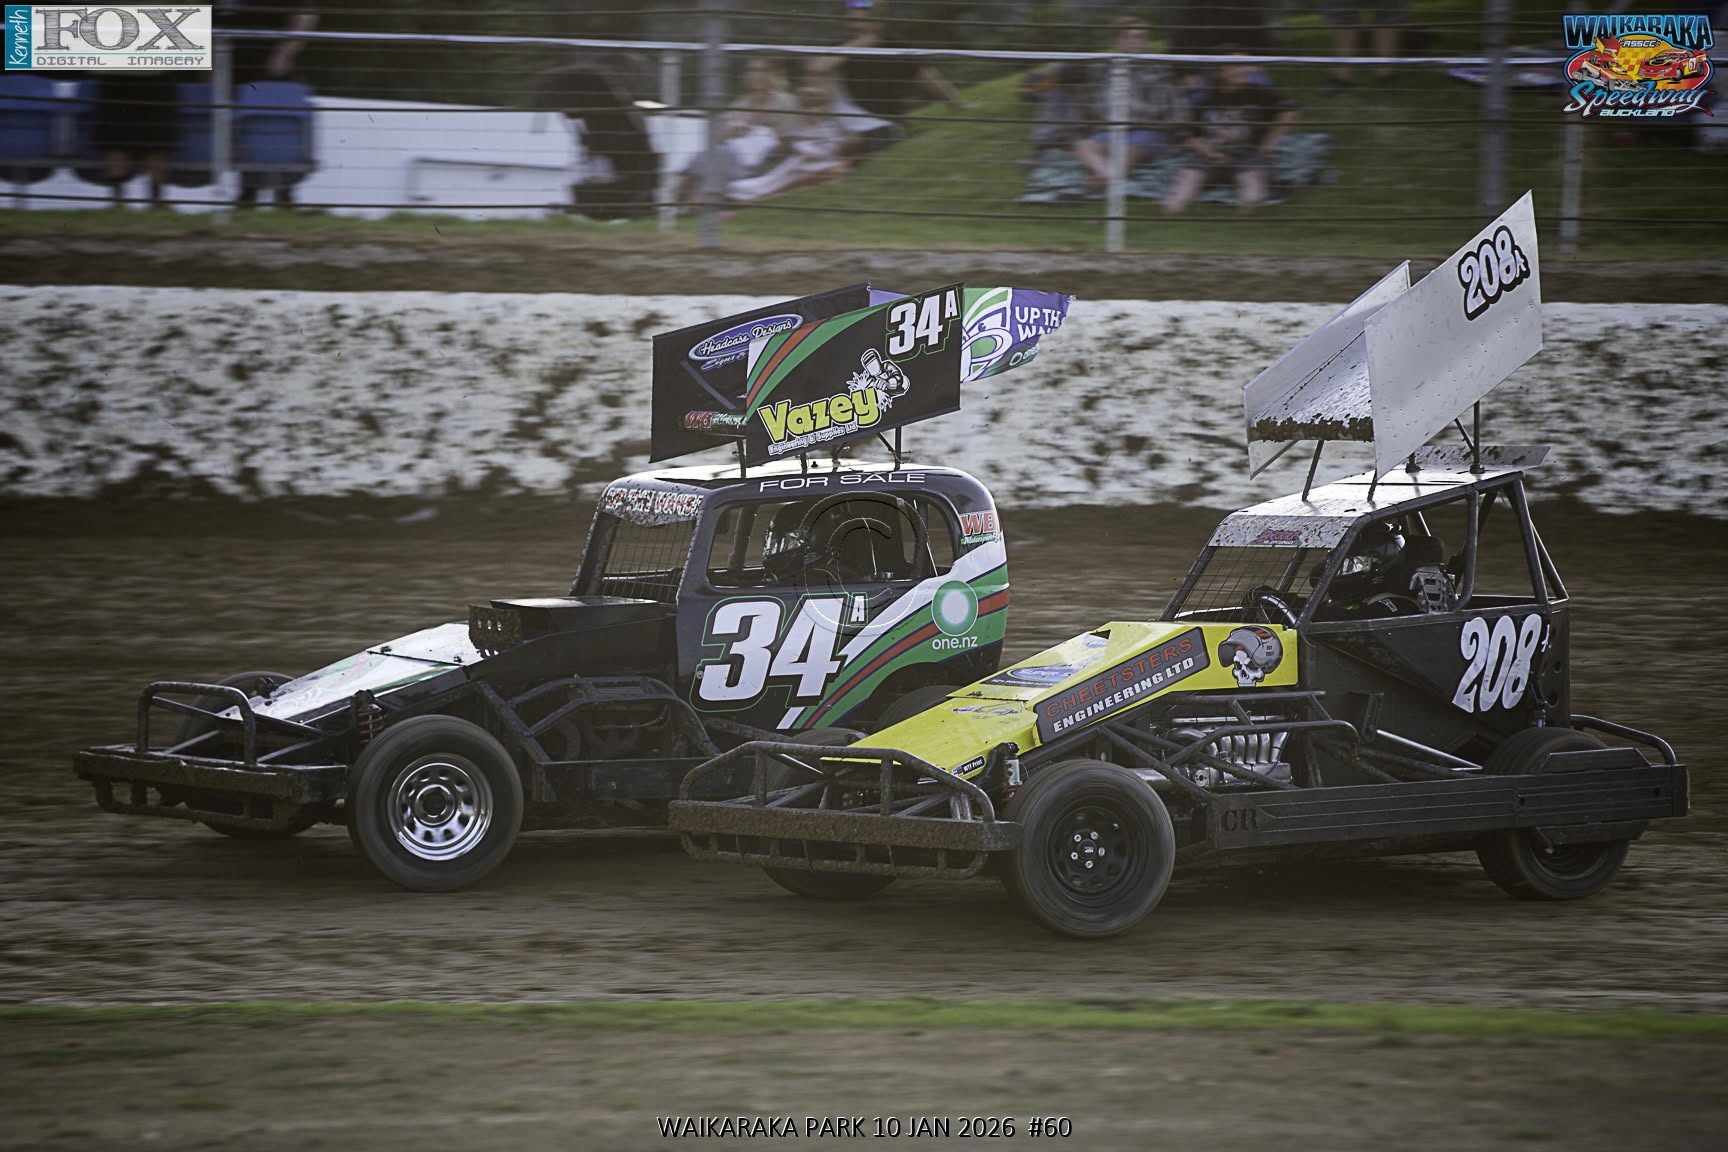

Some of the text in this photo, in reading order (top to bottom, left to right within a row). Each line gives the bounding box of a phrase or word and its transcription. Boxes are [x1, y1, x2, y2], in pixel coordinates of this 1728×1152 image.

[1015, 306, 1041, 324] UP
[700, 319, 793, 355] Headcase Designs
[757, 387, 881, 443] Vazey
[759, 473, 926, 493] FOR SALE
[959, 511, 998, 537] WB
[932, 635, 979, 650] one.nz
[1046, 638, 1193, 718] CHEETSTERS
[1053, 657, 1194, 733] ENGINEERING LTD
